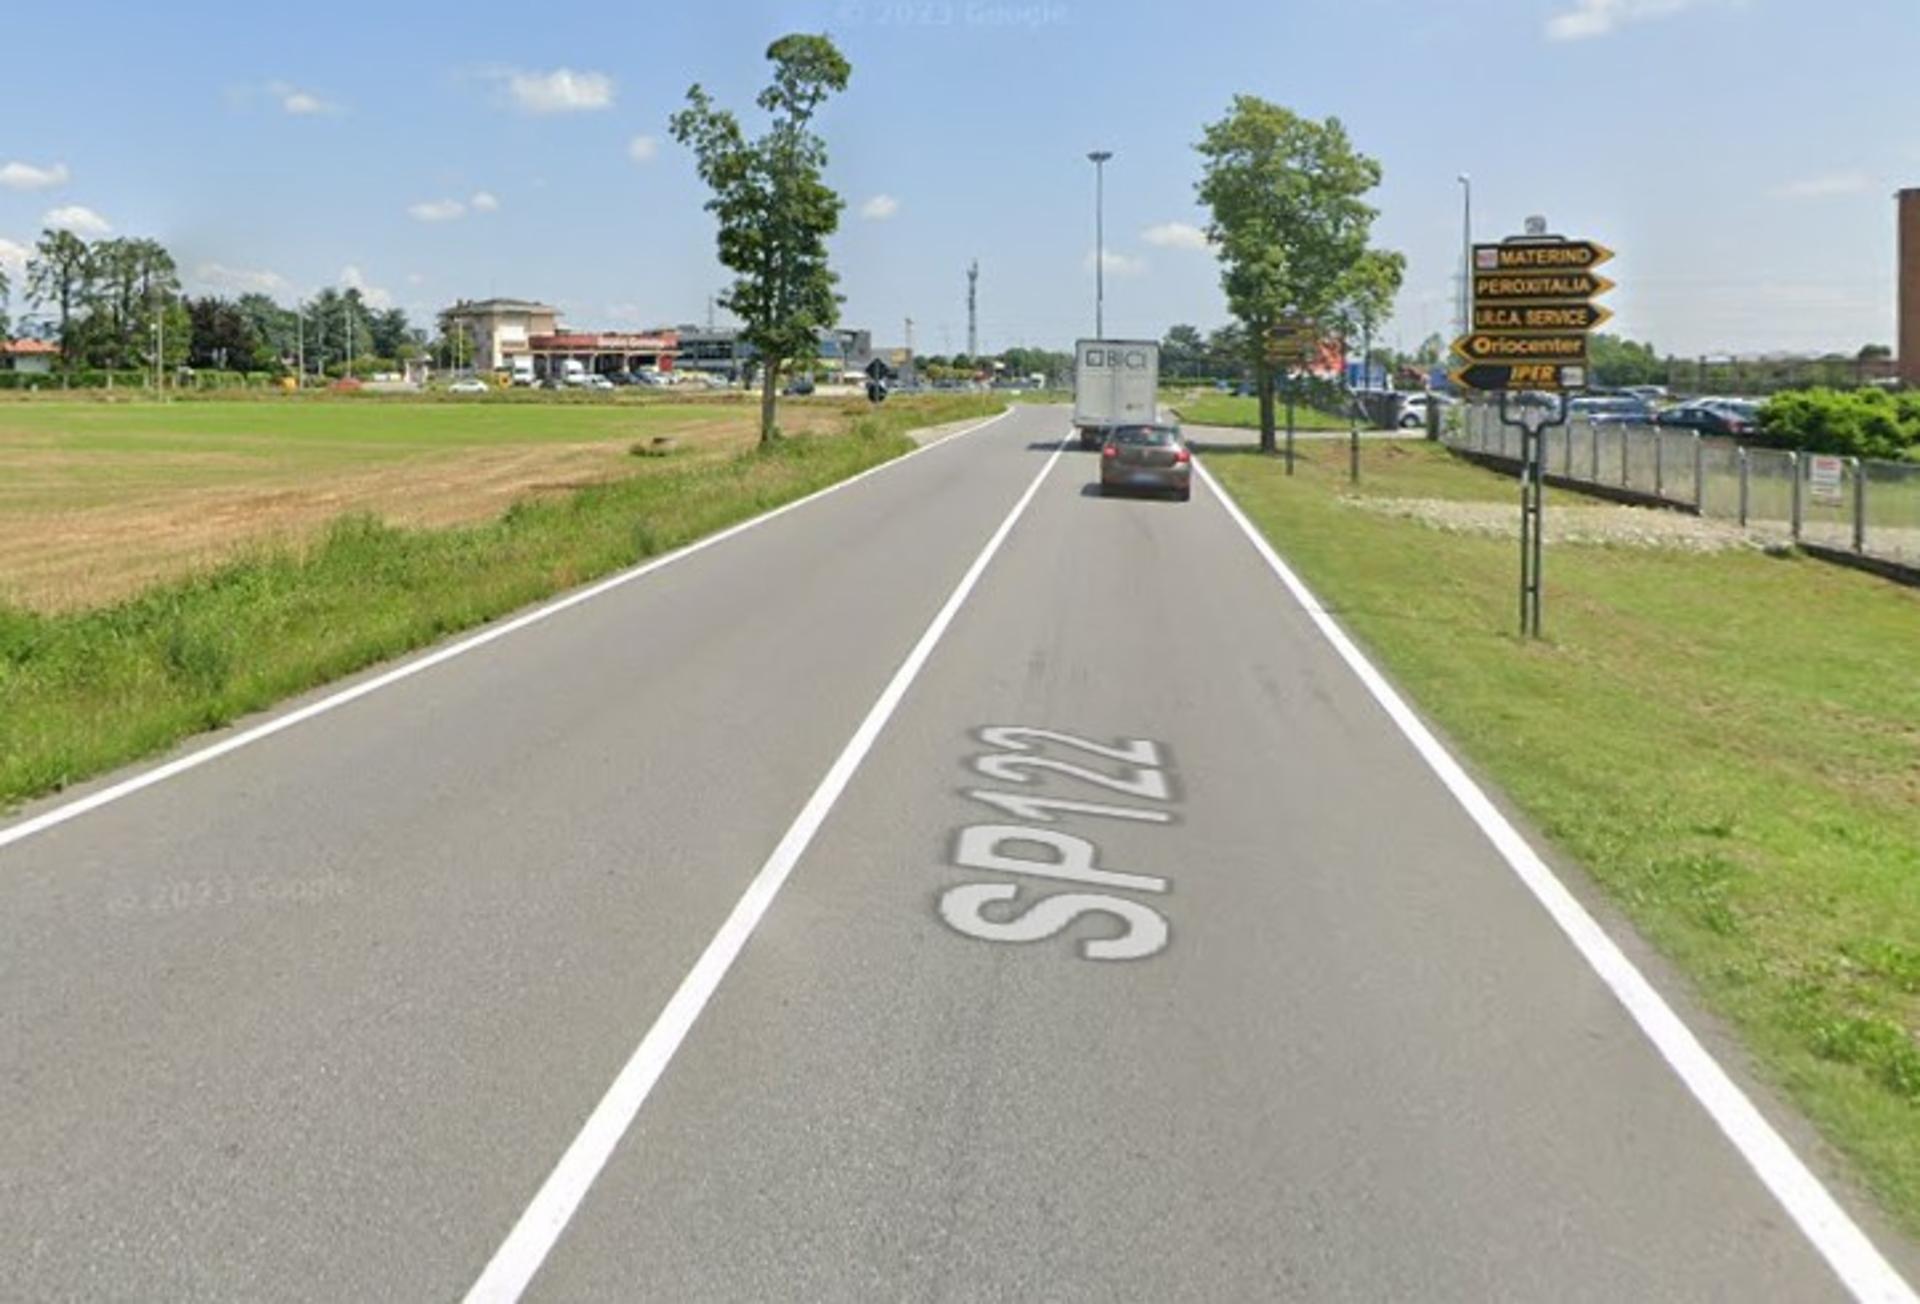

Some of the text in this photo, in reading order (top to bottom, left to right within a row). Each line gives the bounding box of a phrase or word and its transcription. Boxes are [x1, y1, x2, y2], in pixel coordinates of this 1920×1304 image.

[1478, 278, 1590, 294] PEROXITALIA
[1526, 309, 1588, 326] SERVICE
[1472, 336, 1582, 354] Oriocenter
